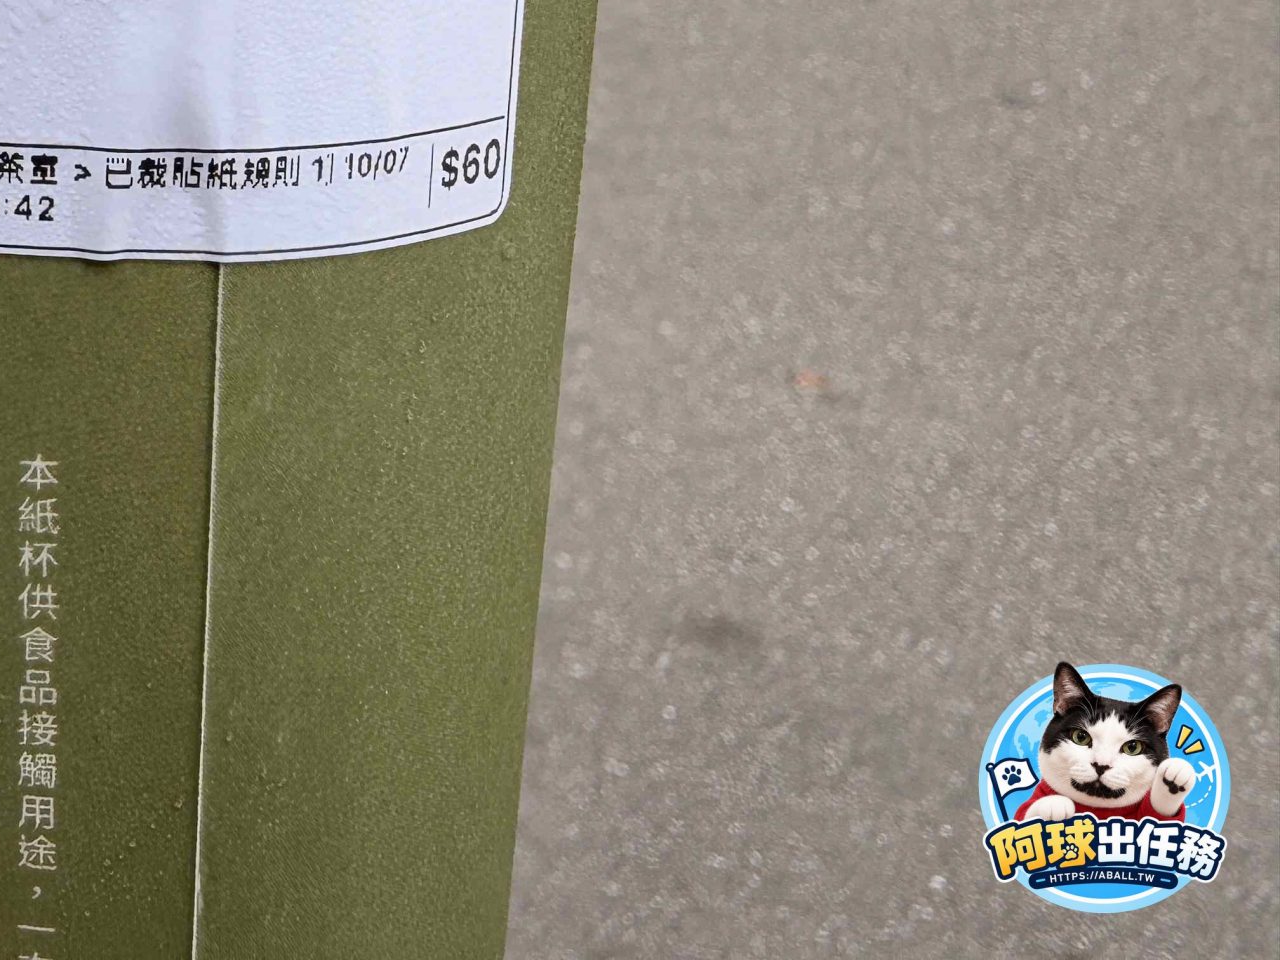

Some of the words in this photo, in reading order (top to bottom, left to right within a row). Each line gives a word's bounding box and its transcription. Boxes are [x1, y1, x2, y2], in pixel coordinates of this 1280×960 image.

[441, 138, 501, 191] $60
[17, 453, 60, 960] 本紙杯供食品接觸用途，一
